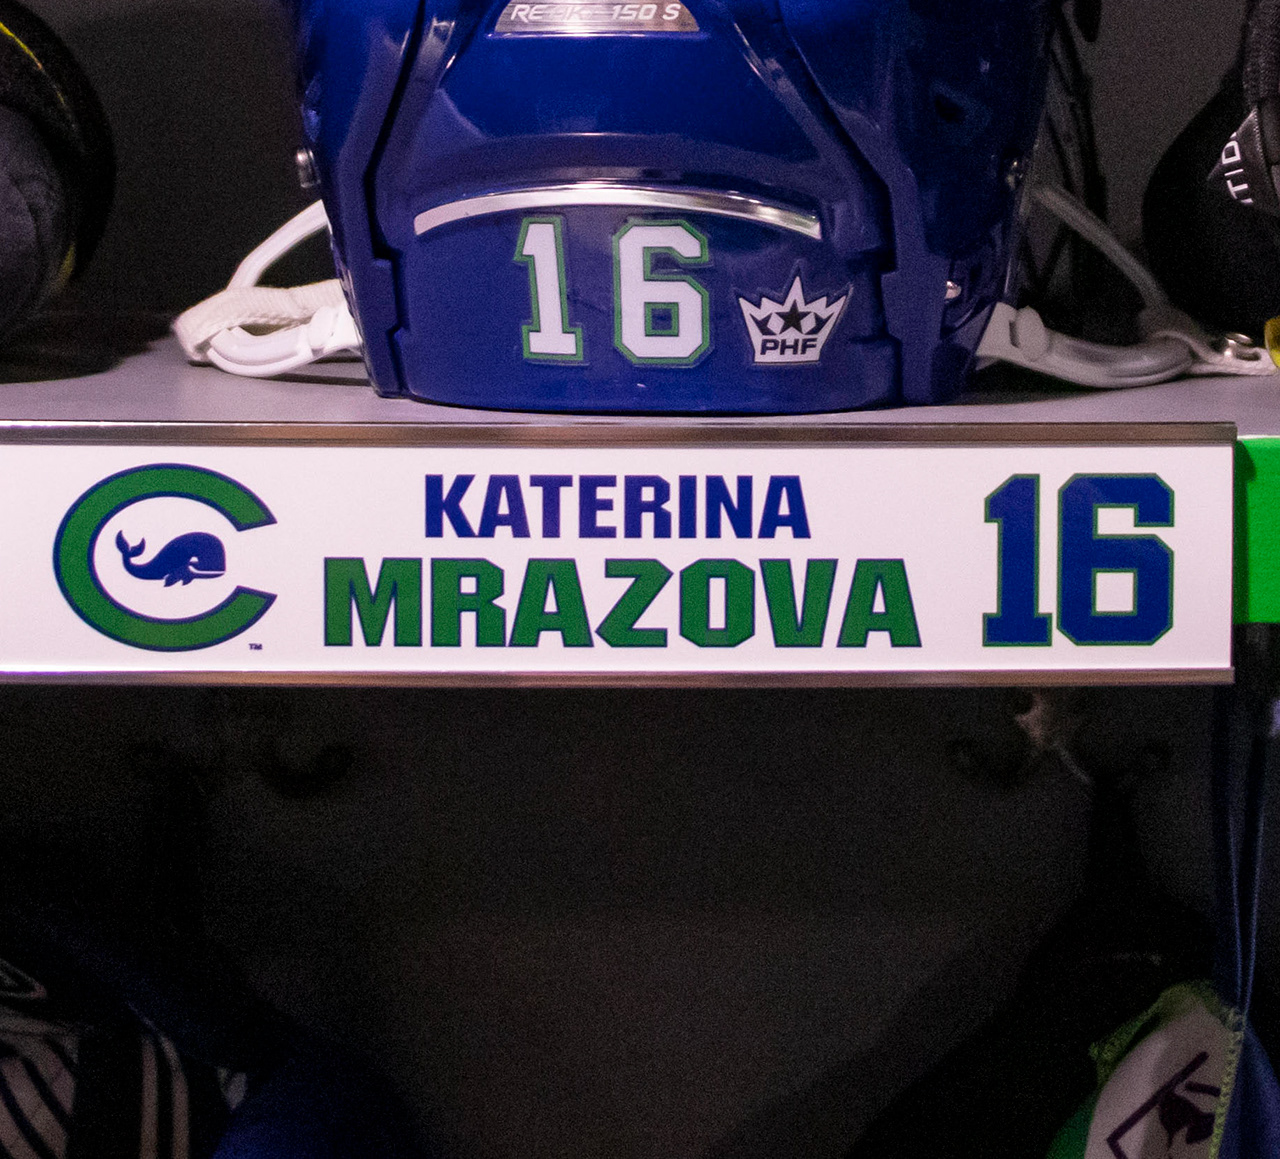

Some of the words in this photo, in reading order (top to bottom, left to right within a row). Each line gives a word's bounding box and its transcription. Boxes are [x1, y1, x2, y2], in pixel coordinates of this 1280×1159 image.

[611, 3, 658, 21] 150
[662, 3, 682, 21] S
[1221, 131, 1254, 205] TID
[512, 215, 715, 367] 16
[760, 337, 819, 356] PHF
[424, 474, 812, 539] KATERINA
[981, 472, 1177, 648] 16
[323, 556, 923, 649] MRAZOVA
